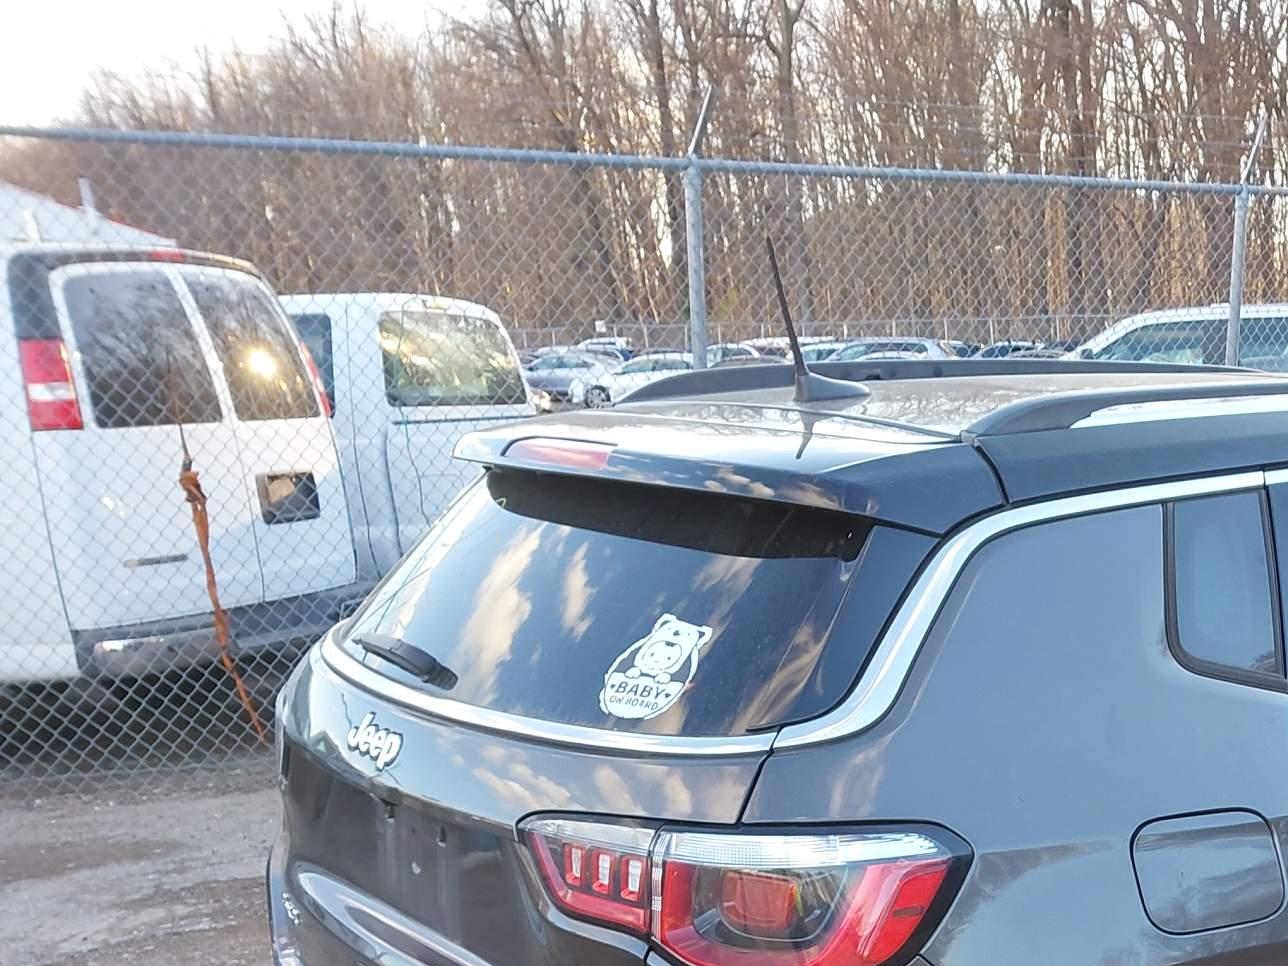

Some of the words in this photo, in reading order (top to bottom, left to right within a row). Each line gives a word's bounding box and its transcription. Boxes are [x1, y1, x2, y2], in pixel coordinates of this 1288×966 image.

[615, 681, 666, 700] BABY
[609, 695, 624, 705] ON
[625, 697, 659, 711] BOARD
[347, 711, 403, 772] Jeep
